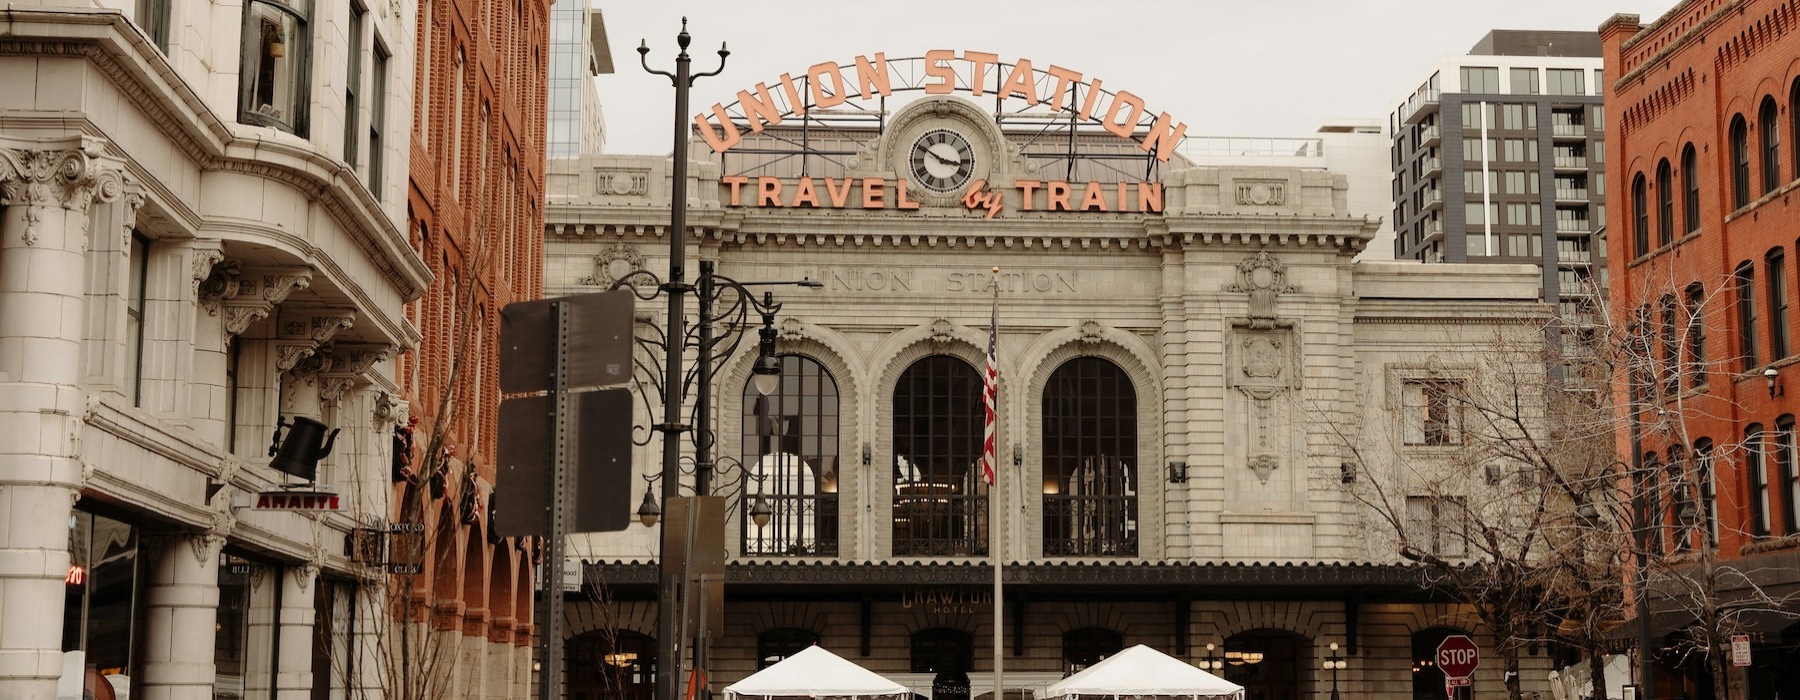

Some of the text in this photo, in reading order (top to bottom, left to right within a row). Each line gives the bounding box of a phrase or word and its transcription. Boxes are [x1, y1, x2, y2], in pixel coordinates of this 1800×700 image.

[694, 52, 892, 153] UNION
[925, 49, 1188, 163] STATION
[723, 176, 1162, 219] TRAVEL by TRAIN
[804, 270, 1080, 293] UNION STATION
[256, 495, 339, 509] AMANTE
[902, 582, 993, 608] CRAWFOR
[934, 606, 974, 614] HOTEL
[1440, 648, 1476, 665] STOP
